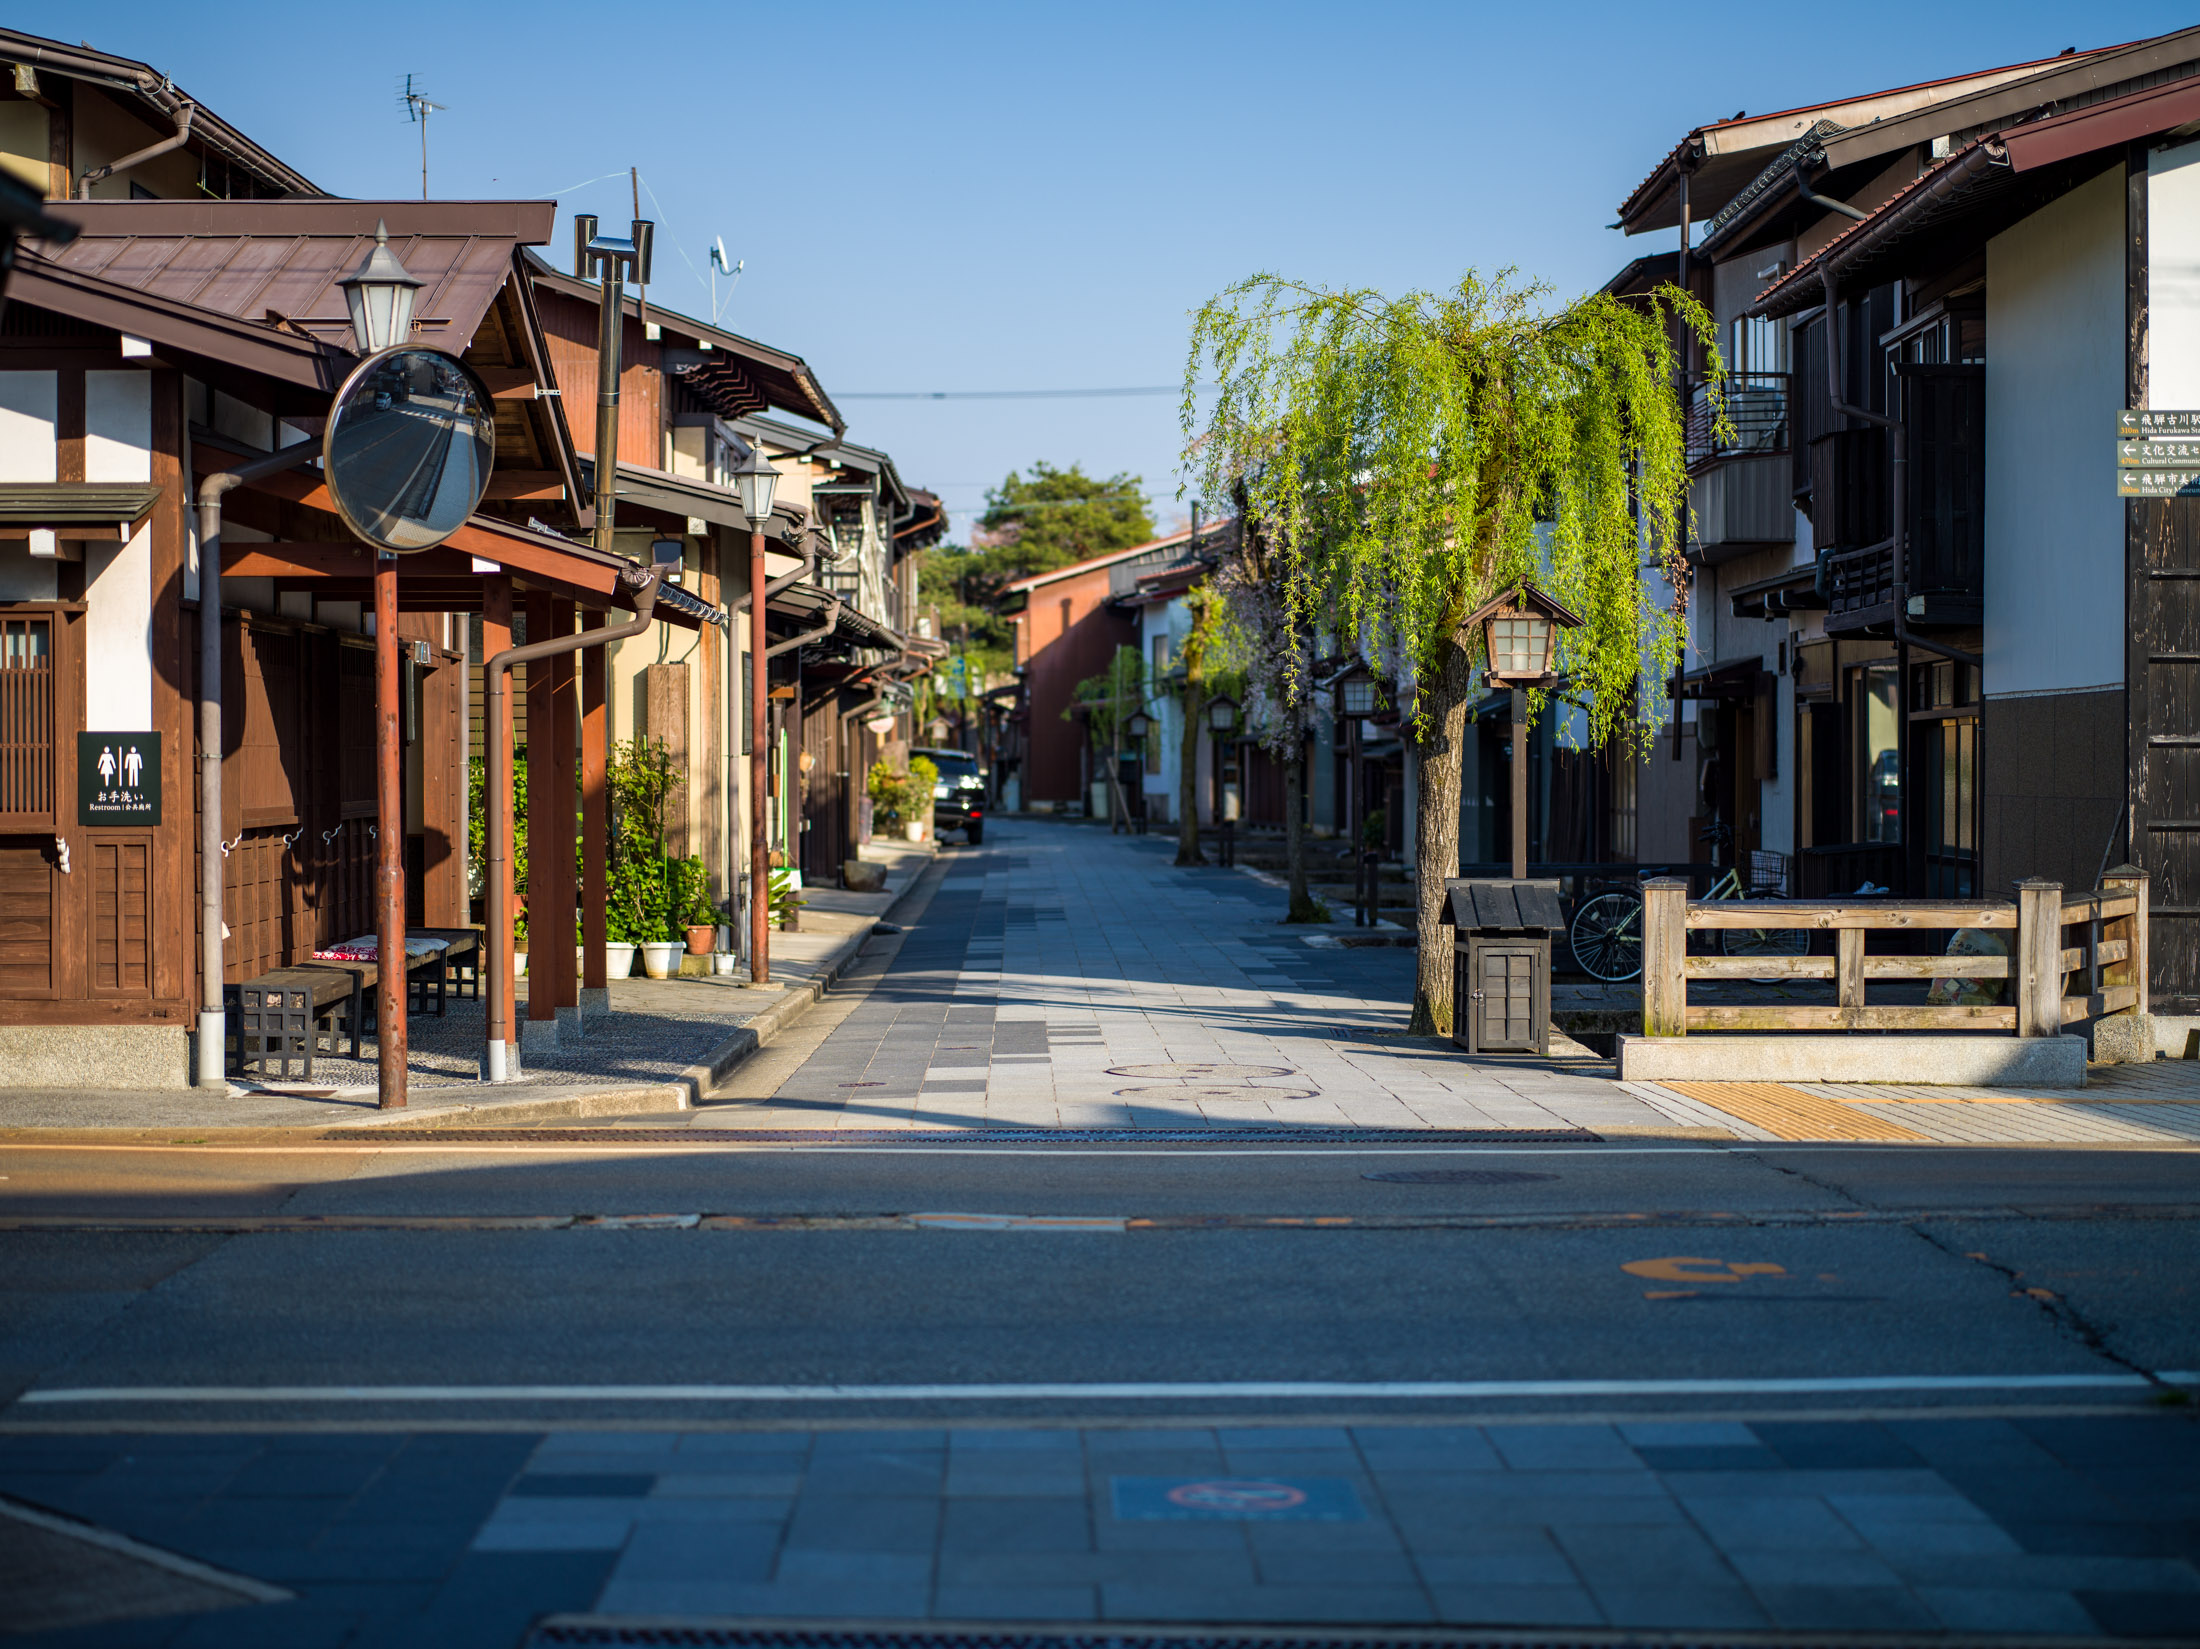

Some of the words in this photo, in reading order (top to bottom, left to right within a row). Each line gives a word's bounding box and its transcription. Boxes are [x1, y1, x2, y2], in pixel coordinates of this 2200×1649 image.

[2142, 444, 2200, 456] 文化交流セ
[2121, 486, 2139, 494] 550m
[2158, 486, 2173, 495] City
[97, 790, 144, 803] お手洗い
[89, 803, 121, 811] Restroom
